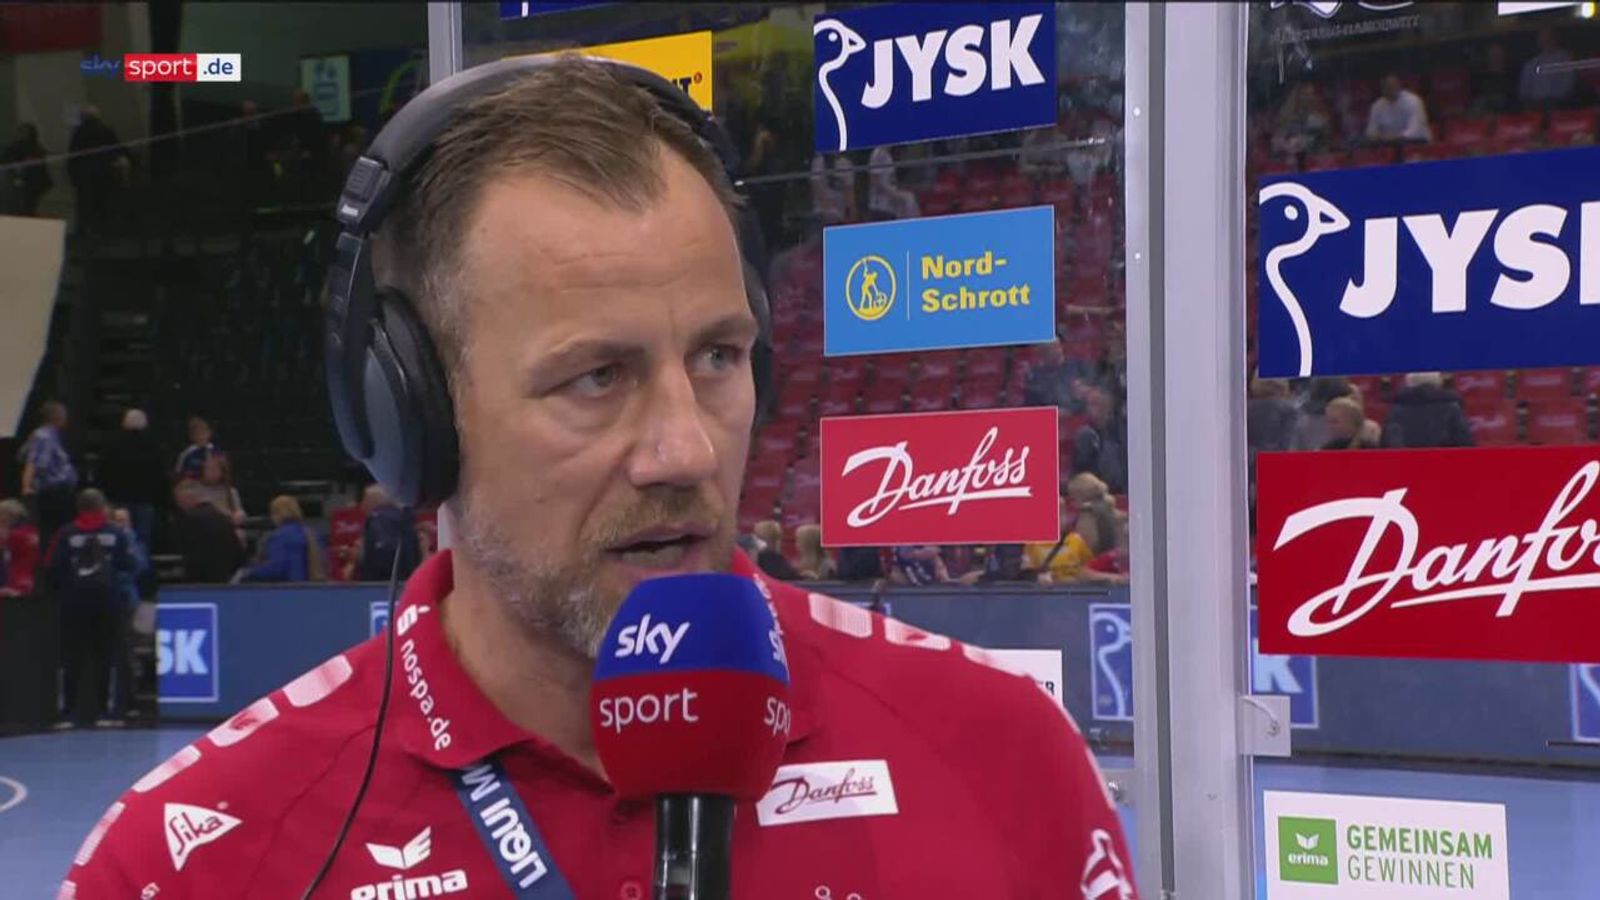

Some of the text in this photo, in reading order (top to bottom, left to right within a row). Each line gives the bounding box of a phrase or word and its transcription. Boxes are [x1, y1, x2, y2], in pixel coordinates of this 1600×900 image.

[861, 13, 1046, 109] JYSK
[921, 250, 1007, 280] Nord-
[922, 283, 1031, 313] Schrott
[842, 427, 1032, 528] Danfoss
[1273, 460, 1600, 636] Danfo
[615, 614, 690, 664] sky
[400, 639, 452, 751] nospa.de
[600, 688, 698, 733] sport
[772, 767, 877, 815] Danfoss
[169, 811, 224, 857] Sika
[479, 797, 548, 889] LIQUI
[1346, 824, 1493, 859] GEMEINSAM
[1288, 853, 1329, 867] erima
[1347, 854, 1475, 889] GEWINNEN
[350, 869, 468, 900] erima
